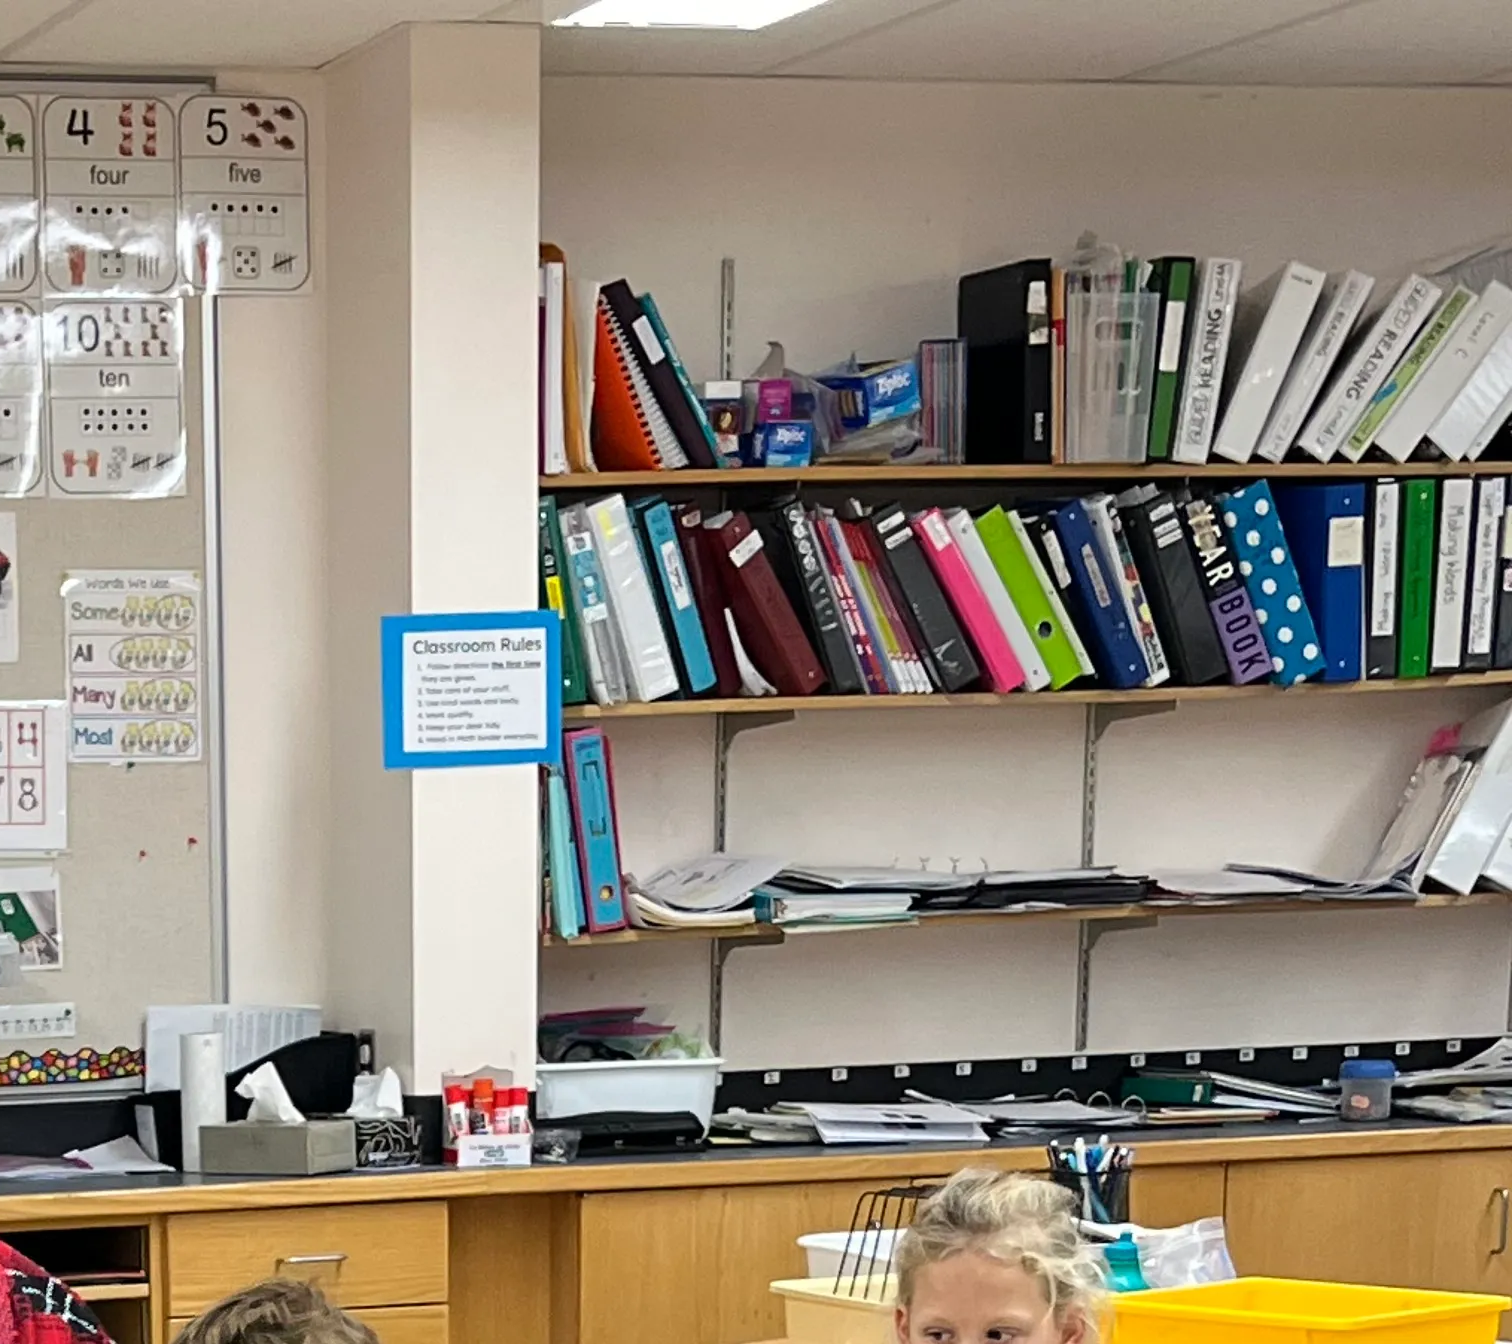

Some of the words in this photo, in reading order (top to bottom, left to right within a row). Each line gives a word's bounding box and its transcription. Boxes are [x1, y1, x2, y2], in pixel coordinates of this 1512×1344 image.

[67, 108, 94, 146] 4
[205, 108, 229, 146] 5
[90, 164, 131, 186] four
[228, 162, 263, 184] five
[56, 314, 101, 353] 10
[1346, 328, 1398, 401] READING
[98, 368, 131, 389] ten
[71, 601, 120, 621] Some
[413, 639, 496, 655] Classroom
[500, 637, 542, 652] Rules
[1219, 592, 1266, 676] BOOK
[73, 643, 94, 662] All
[72, 685, 116, 710] Many
[17, 721, 39, 758] 4
[74, 726, 113, 746] Most
[17, 777, 39, 812] 8
